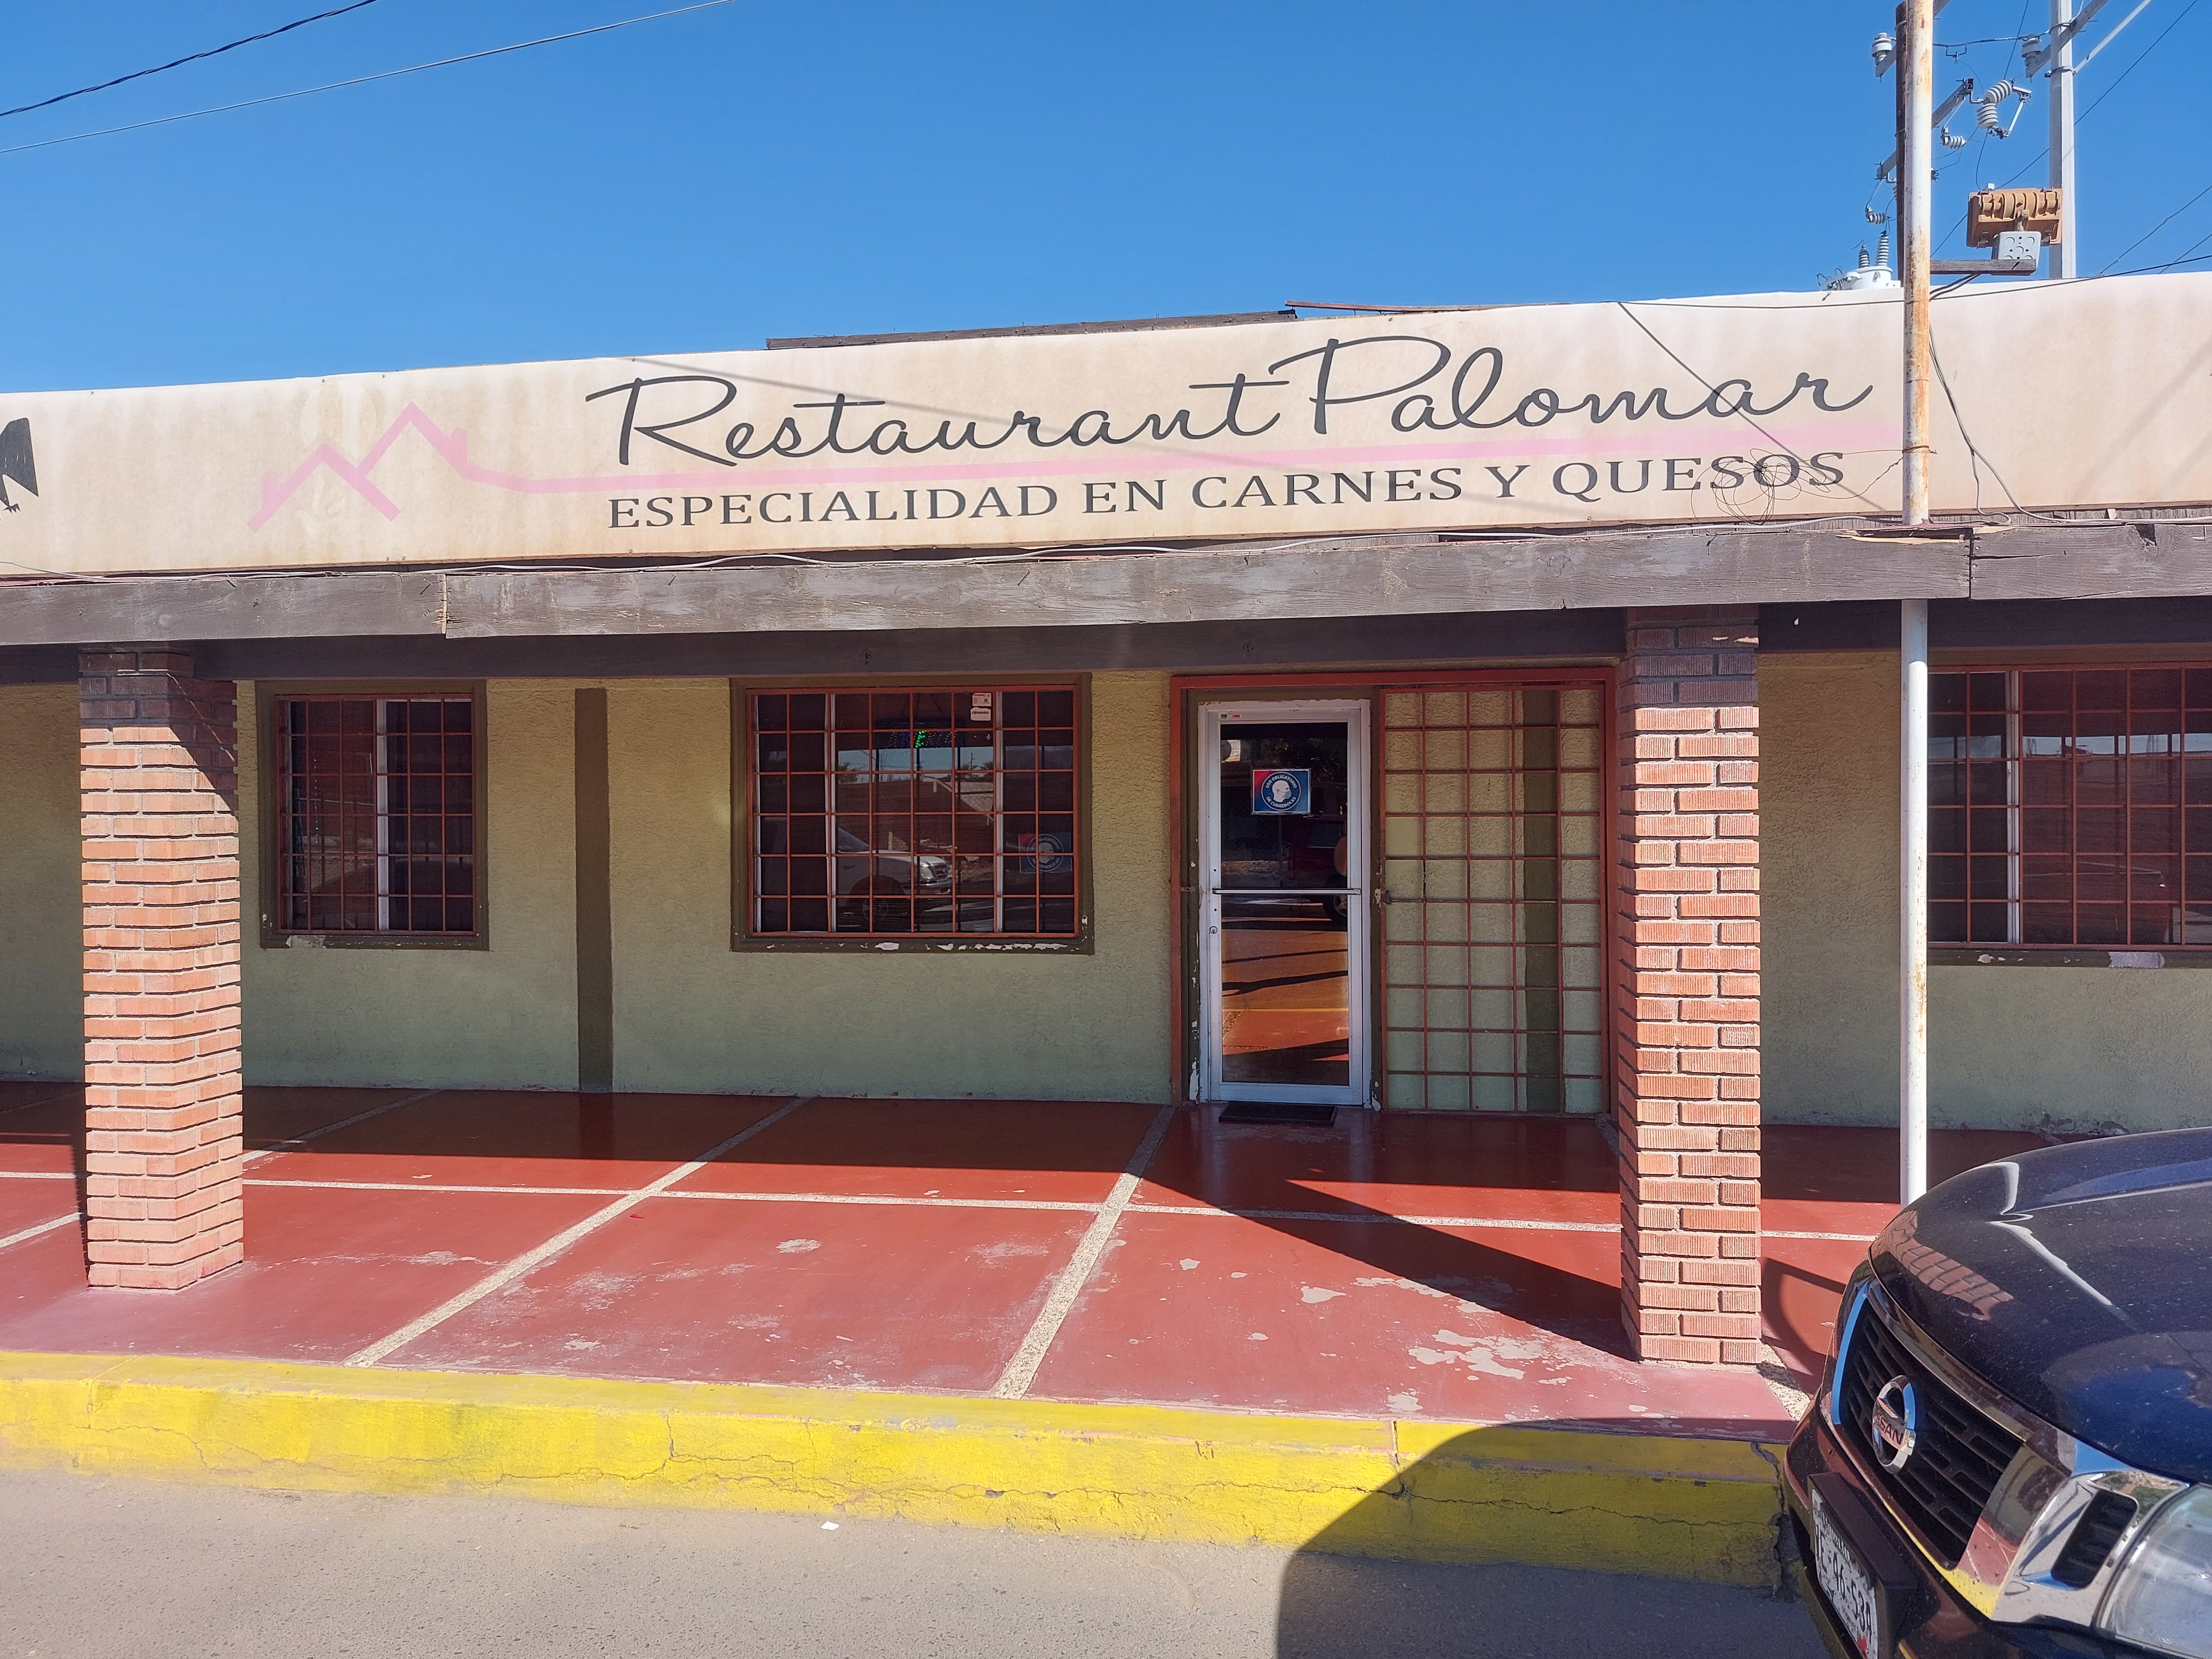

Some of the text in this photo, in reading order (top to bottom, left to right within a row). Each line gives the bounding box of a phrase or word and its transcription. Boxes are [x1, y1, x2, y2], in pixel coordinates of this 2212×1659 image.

[586, 335, 1873, 467] Restaurant Palomar
[608, 452, 1844, 528] ESPECIALIDAD EN CARNES Y QUESOS
